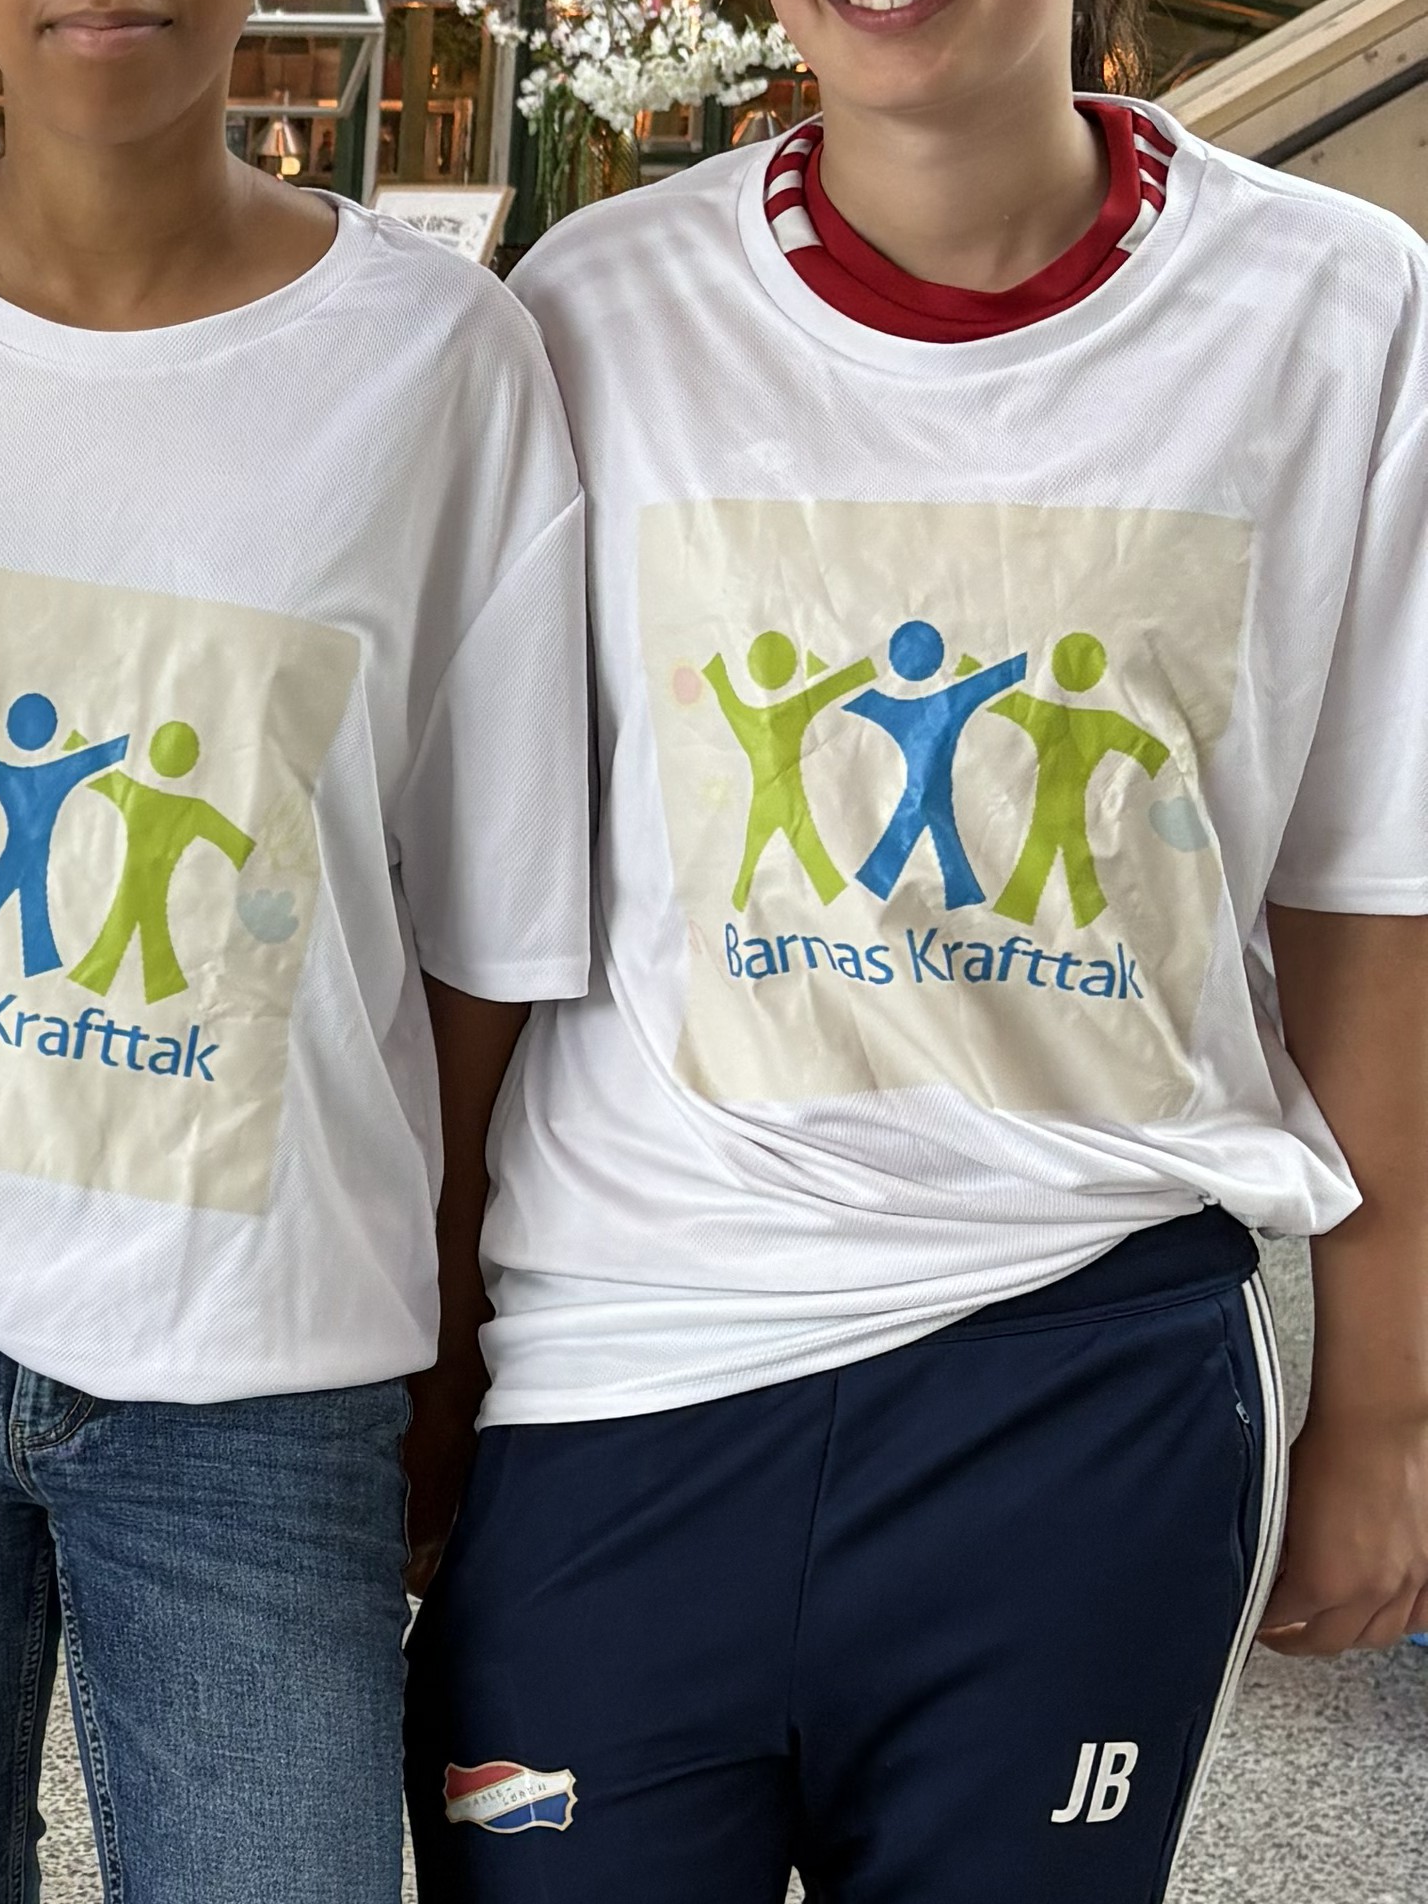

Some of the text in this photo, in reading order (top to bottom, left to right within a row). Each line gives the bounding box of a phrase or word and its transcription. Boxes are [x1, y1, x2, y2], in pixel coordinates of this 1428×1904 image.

[725, 922, 1144, 999] Barnas Krafttak
[1051, 1741, 1139, 1823] JB
